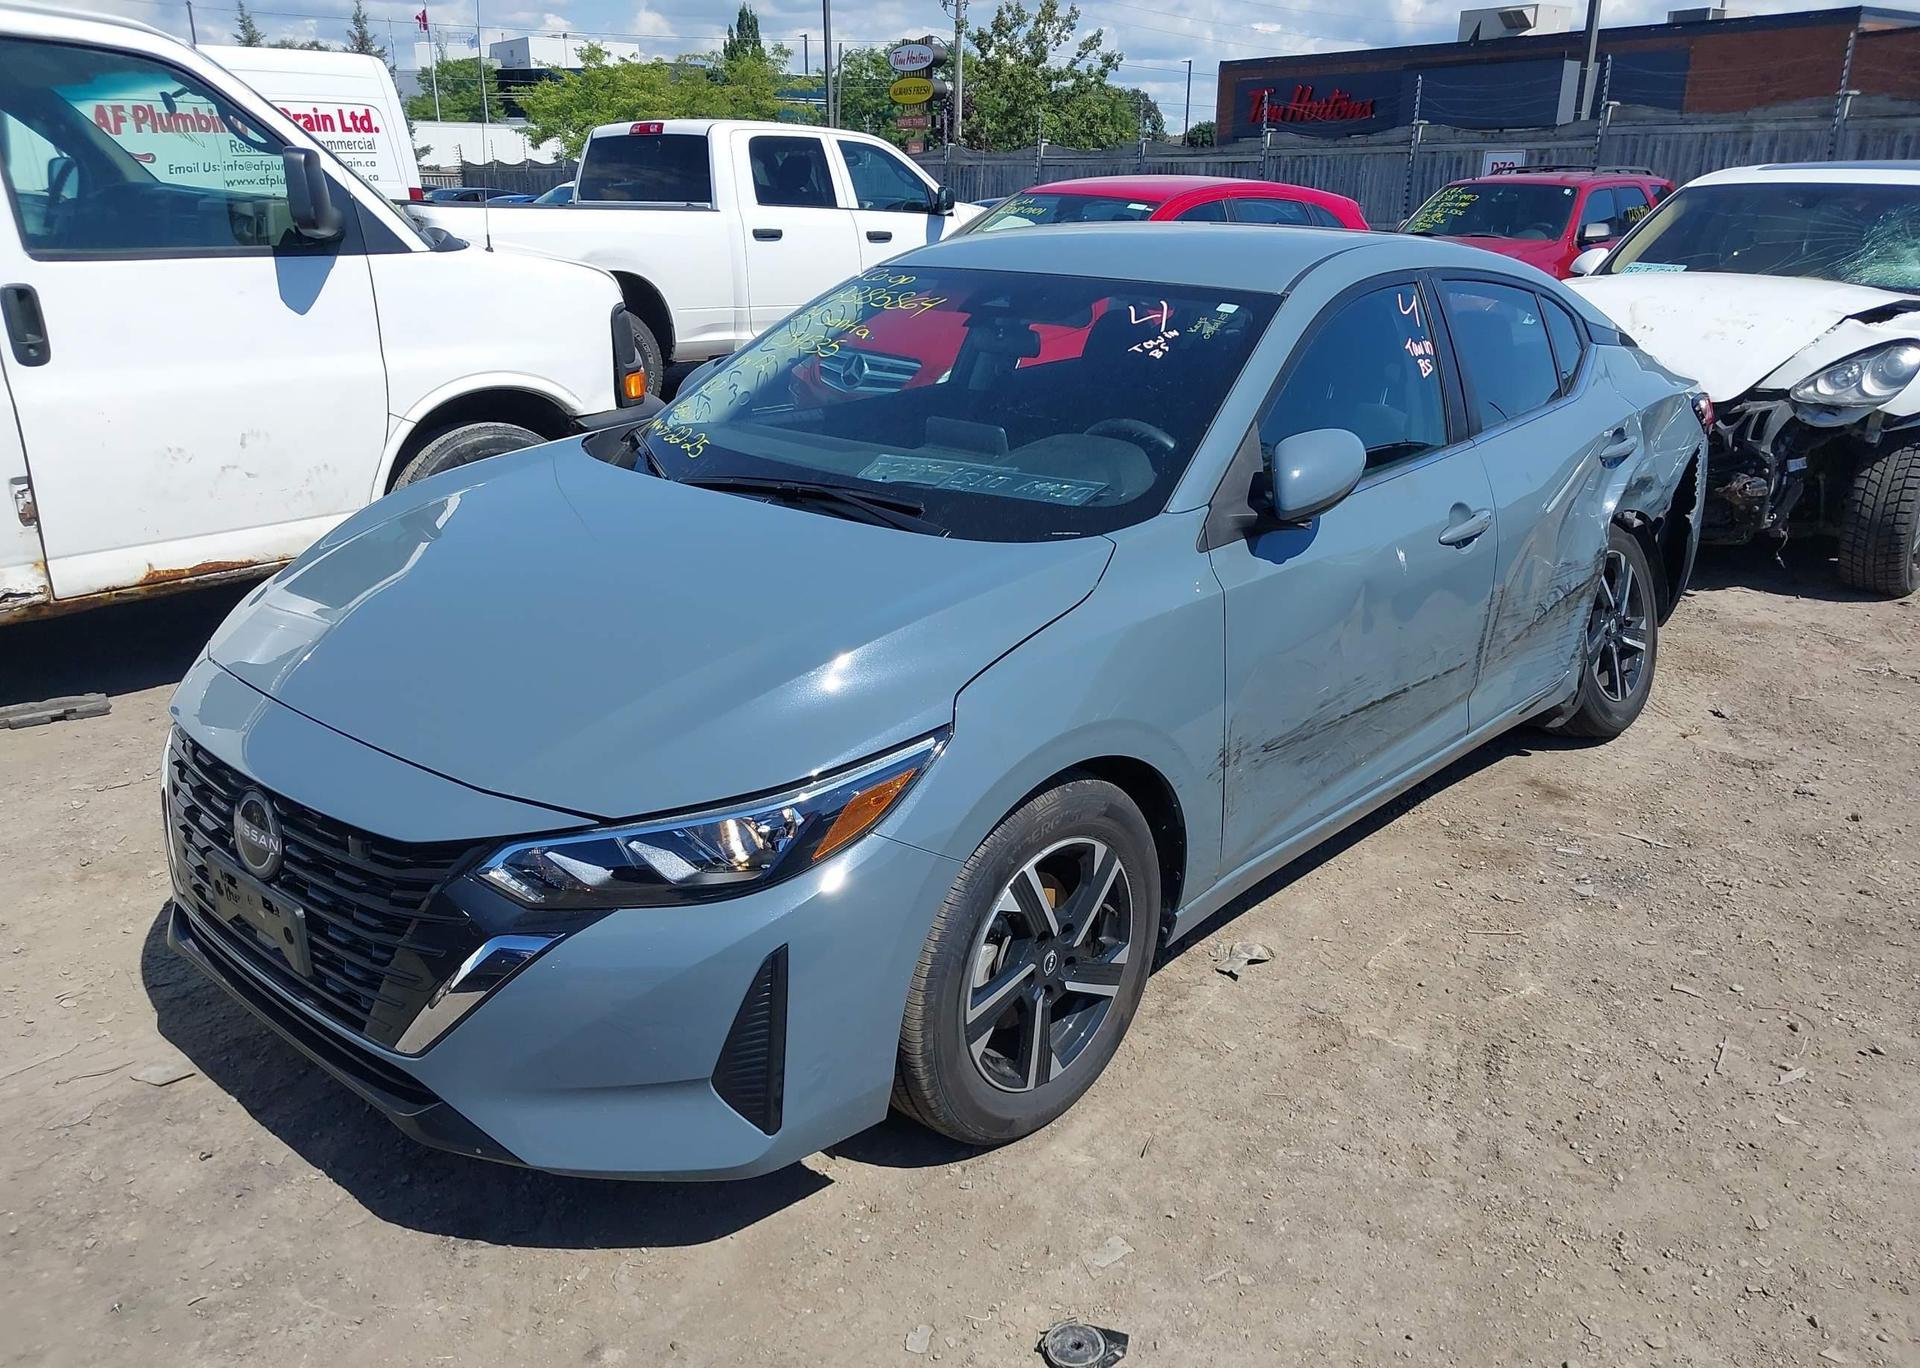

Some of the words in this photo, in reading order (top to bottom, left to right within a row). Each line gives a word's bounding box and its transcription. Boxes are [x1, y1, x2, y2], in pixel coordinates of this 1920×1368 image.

[892, 51, 906, 67] Tim
[905, 49, 931, 65] Hortons
[912, 85, 931, 96] FRESH
[1247, 86, 1284, 124] Tim
[1287, 84, 1375, 122] Hortons
[94, 104, 127, 135] AF
[337, 107, 380, 134] Ltd.
[321, 137, 377, 151] ommercial
[168, 162, 200, 175] Email
[202, 162, 221, 173] Us:
[1128, 300, 1168, 333] 4
[1417, 358, 1434, 379] BS
